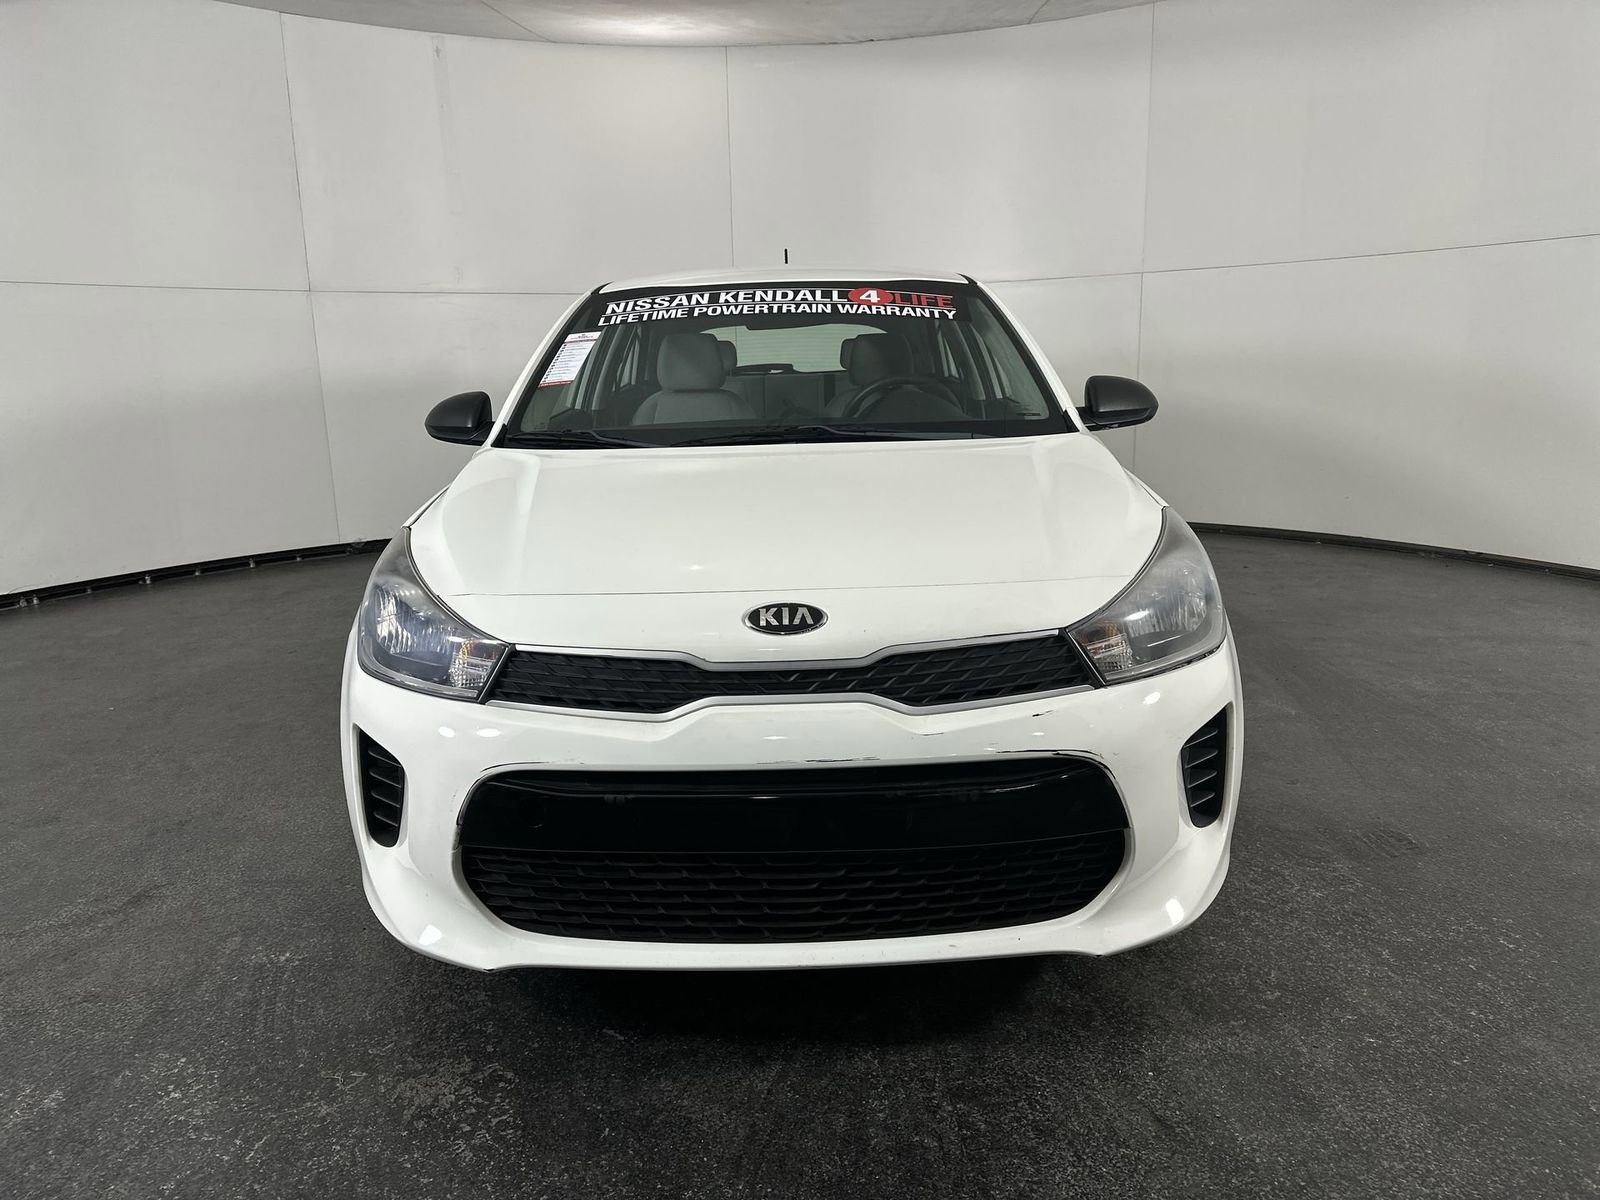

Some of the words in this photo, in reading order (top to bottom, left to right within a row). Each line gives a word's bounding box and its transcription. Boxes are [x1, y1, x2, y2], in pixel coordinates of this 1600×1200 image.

[605, 293, 710, 315] NISSAN
[718, 289, 848, 304] KENDALL
[859, 289, 881, 303] 4
[894, 292, 954, 307] LIFE
[597, 307, 689, 326] LIFETIME
[693, 303, 832, 317] POWERTRAIN
[836, 303, 957, 319] WARRANTY
[758, 606, 814, 626] KIA
